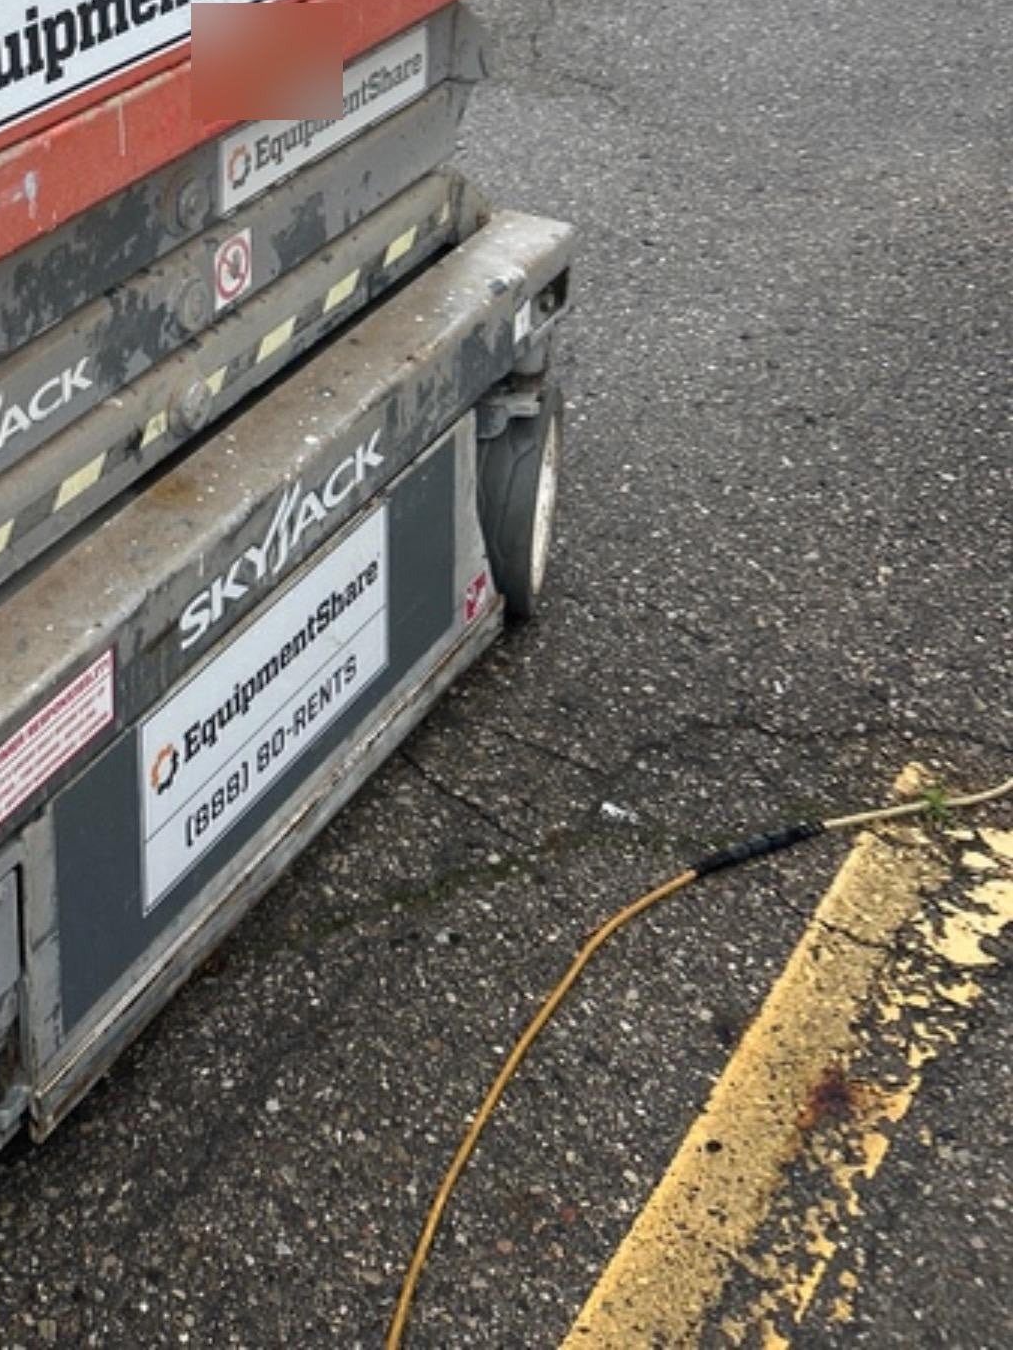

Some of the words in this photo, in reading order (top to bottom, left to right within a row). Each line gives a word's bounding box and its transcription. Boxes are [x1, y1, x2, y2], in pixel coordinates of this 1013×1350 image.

[254, 53, 423, 171] EquipntShare
[180, 428, 384, 650] SKYJACK
[183, 560, 379, 763] EquipmentShare
